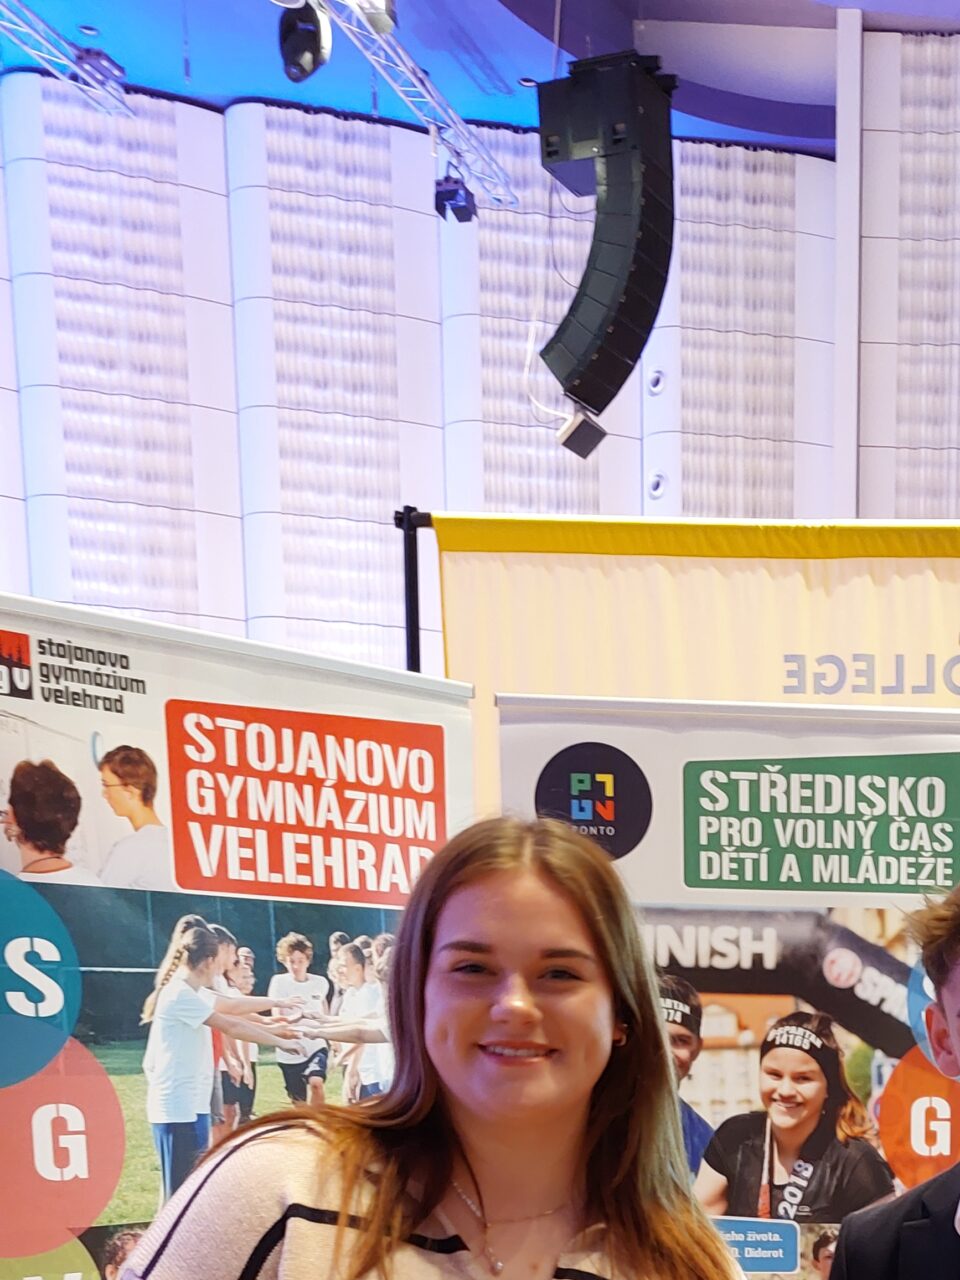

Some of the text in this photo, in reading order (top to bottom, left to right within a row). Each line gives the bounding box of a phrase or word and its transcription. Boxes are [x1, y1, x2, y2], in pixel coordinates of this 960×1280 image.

[37, 638, 130, 670] stojanovo
[39, 662, 147, 695] gymnázium
[40, 685, 125, 714] velehrad
[183, 712, 435, 794] STOJANOVO
[186, 768, 437, 841] GYMNÁZIUM
[699, 764, 946, 818] STŘEDISKO
[699, 814, 954, 853] PRO VOLNÝ ČAS
[700, 845, 954, 887] DĚTÍ A MLÁDEŽE
[4, 937, 65, 1018] S
[31, 1103, 89, 1182] G
[910, 1096, 951, 1157] G
[778, 1159, 814, 1220] 2018
[744, 1246, 784, 1258] Diderot
